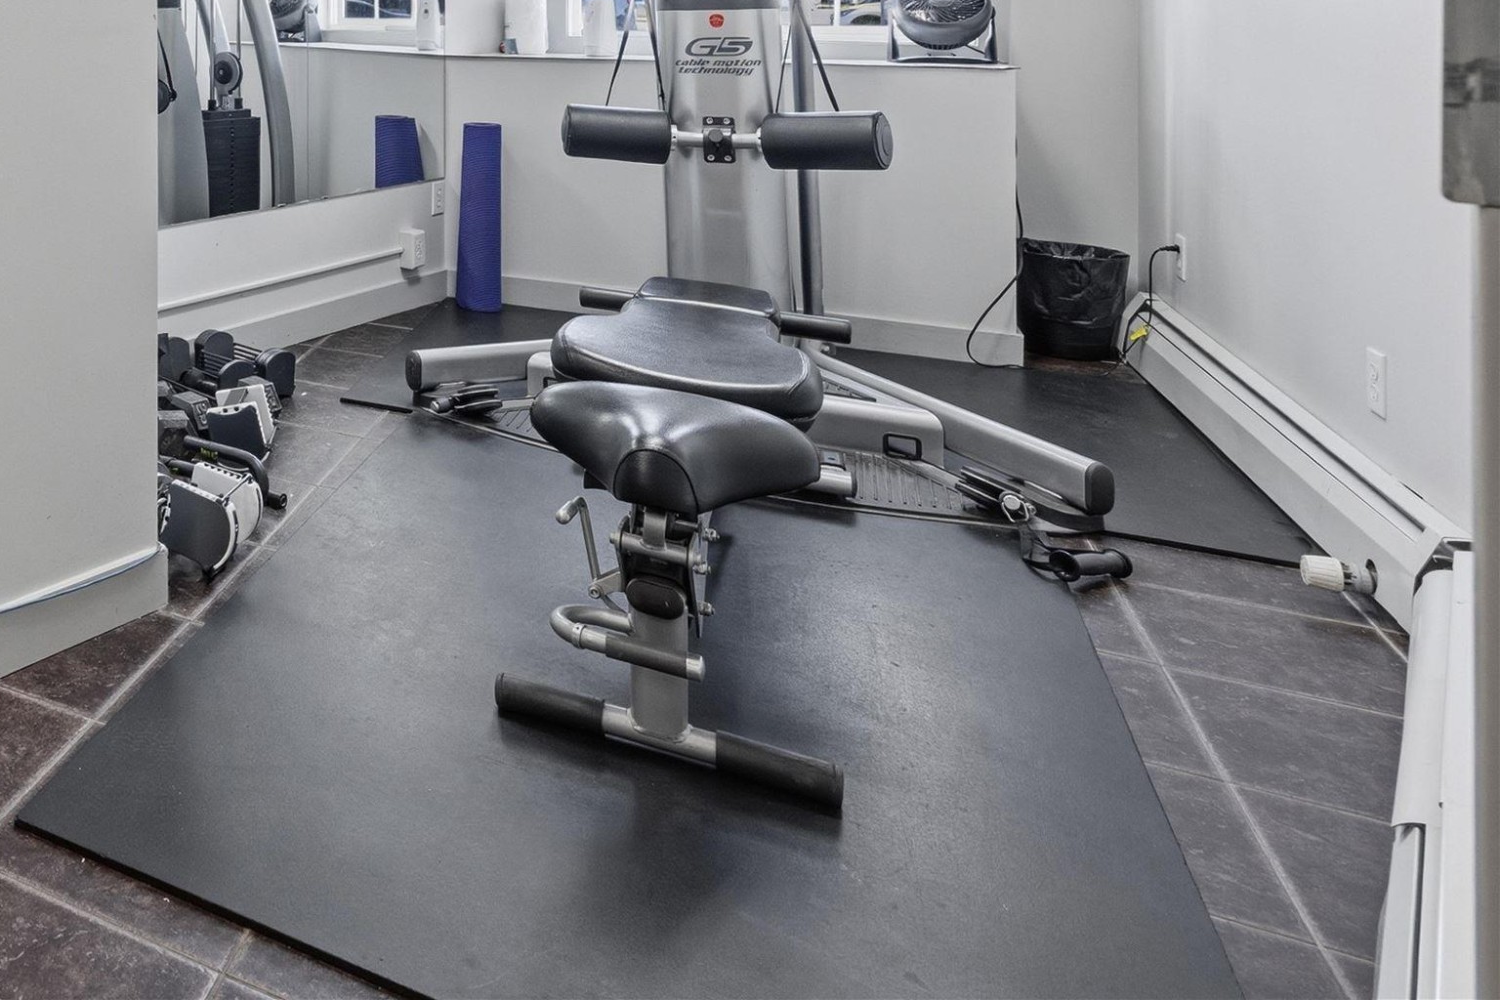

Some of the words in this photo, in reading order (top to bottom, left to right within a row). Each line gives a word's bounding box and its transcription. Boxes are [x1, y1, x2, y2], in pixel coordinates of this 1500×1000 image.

[685, 36, 753, 57] G5
[675, 59, 710, 67] cable
[712, 59, 762, 67] motion
[678, 66, 754, 77] technology
